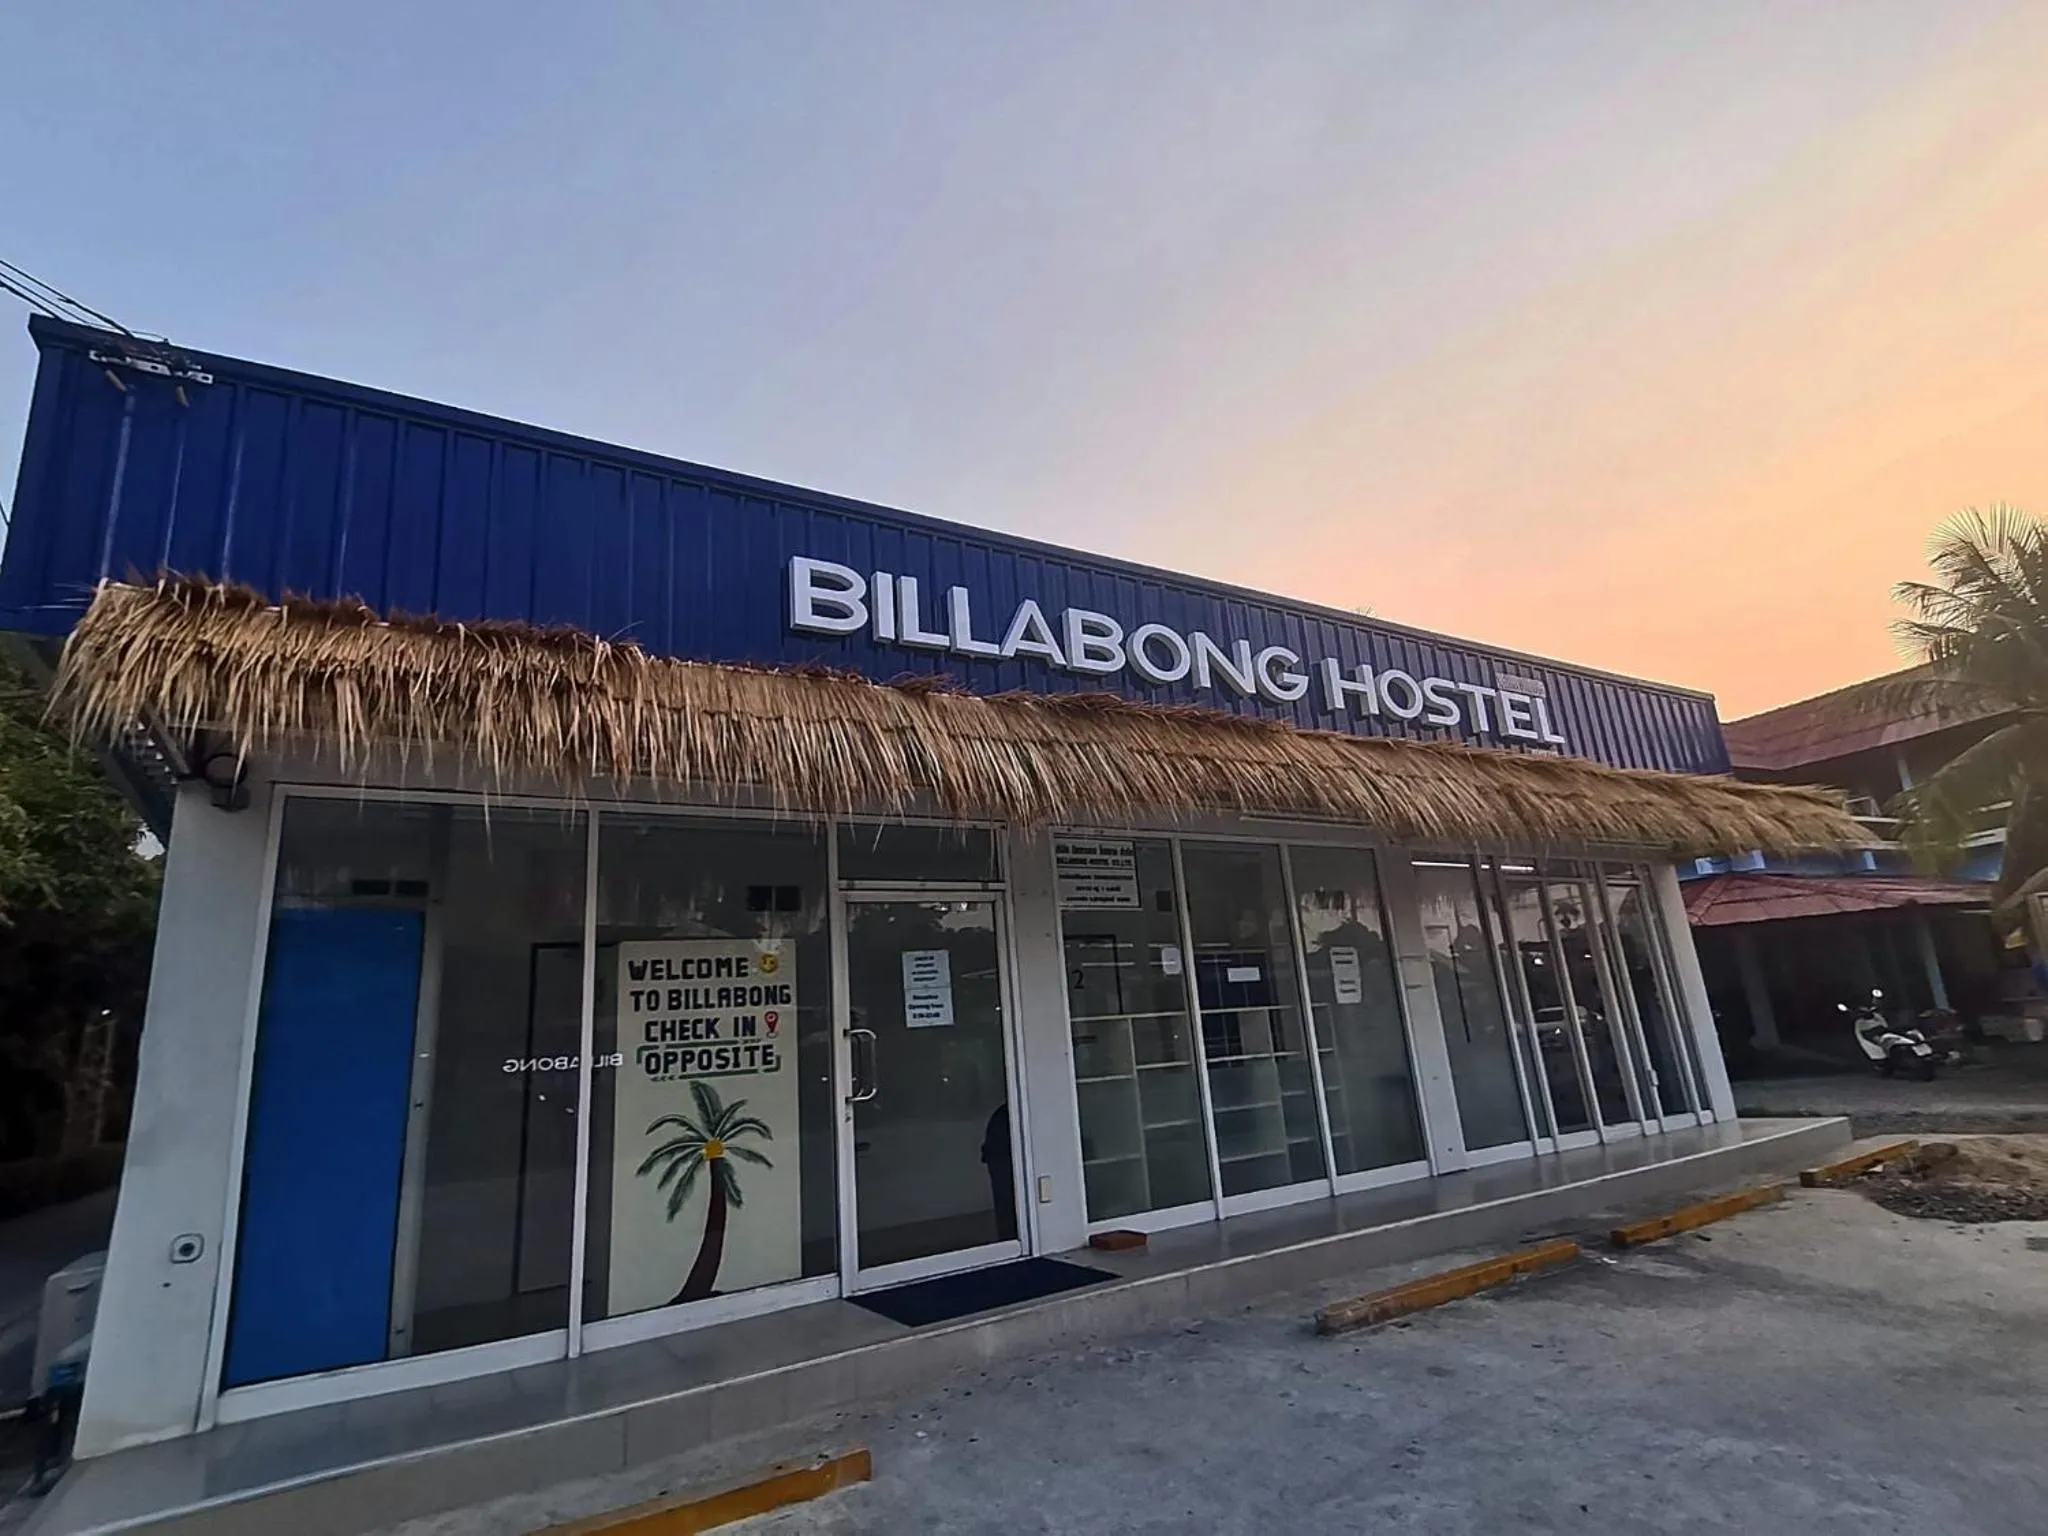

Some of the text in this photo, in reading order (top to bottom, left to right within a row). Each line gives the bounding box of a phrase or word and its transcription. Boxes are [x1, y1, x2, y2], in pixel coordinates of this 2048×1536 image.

[789, 555, 1565, 745] BILLABONG HOSTEL
[628, 957, 749, 981] WELCOME
[629, 984, 792, 1012] TO BILLABONG
[645, 1015, 756, 1042] CHECK IN
[645, 1044, 774, 1074] OPPOSITE
